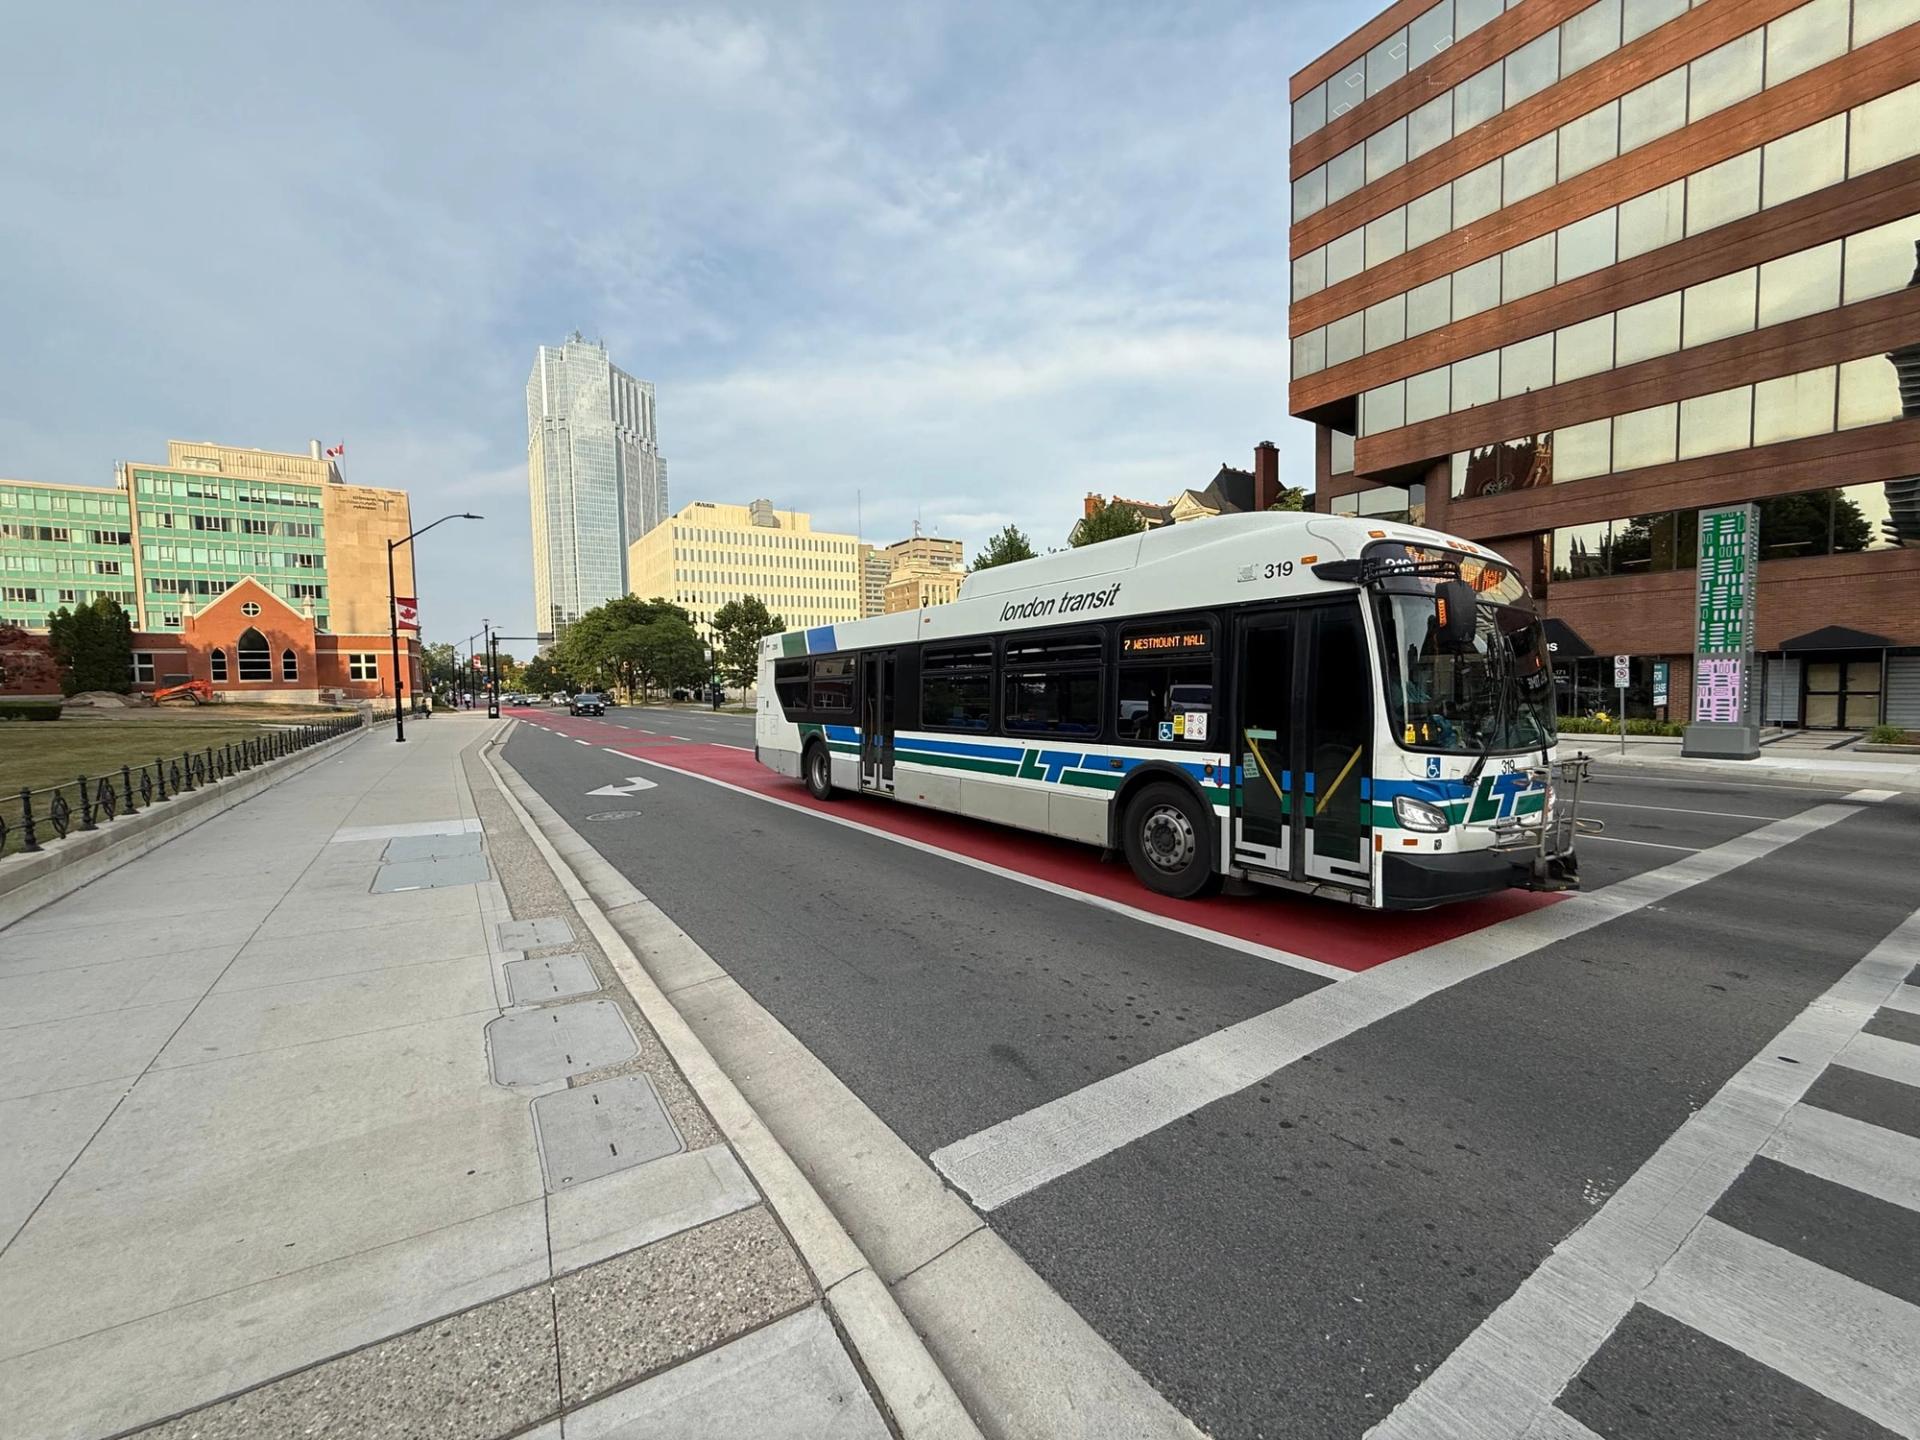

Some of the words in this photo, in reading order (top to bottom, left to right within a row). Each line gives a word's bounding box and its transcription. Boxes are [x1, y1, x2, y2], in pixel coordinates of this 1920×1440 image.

[1264, 561, 1293, 579] 319
[1000, 596, 1055, 622] london
[1058, 582, 1121, 613] transit
[1133, 635, 1180, 650] WESTMOUNT
[1183, 633, 1205, 646] MALL
[1501, 760, 1515, 774] 319
